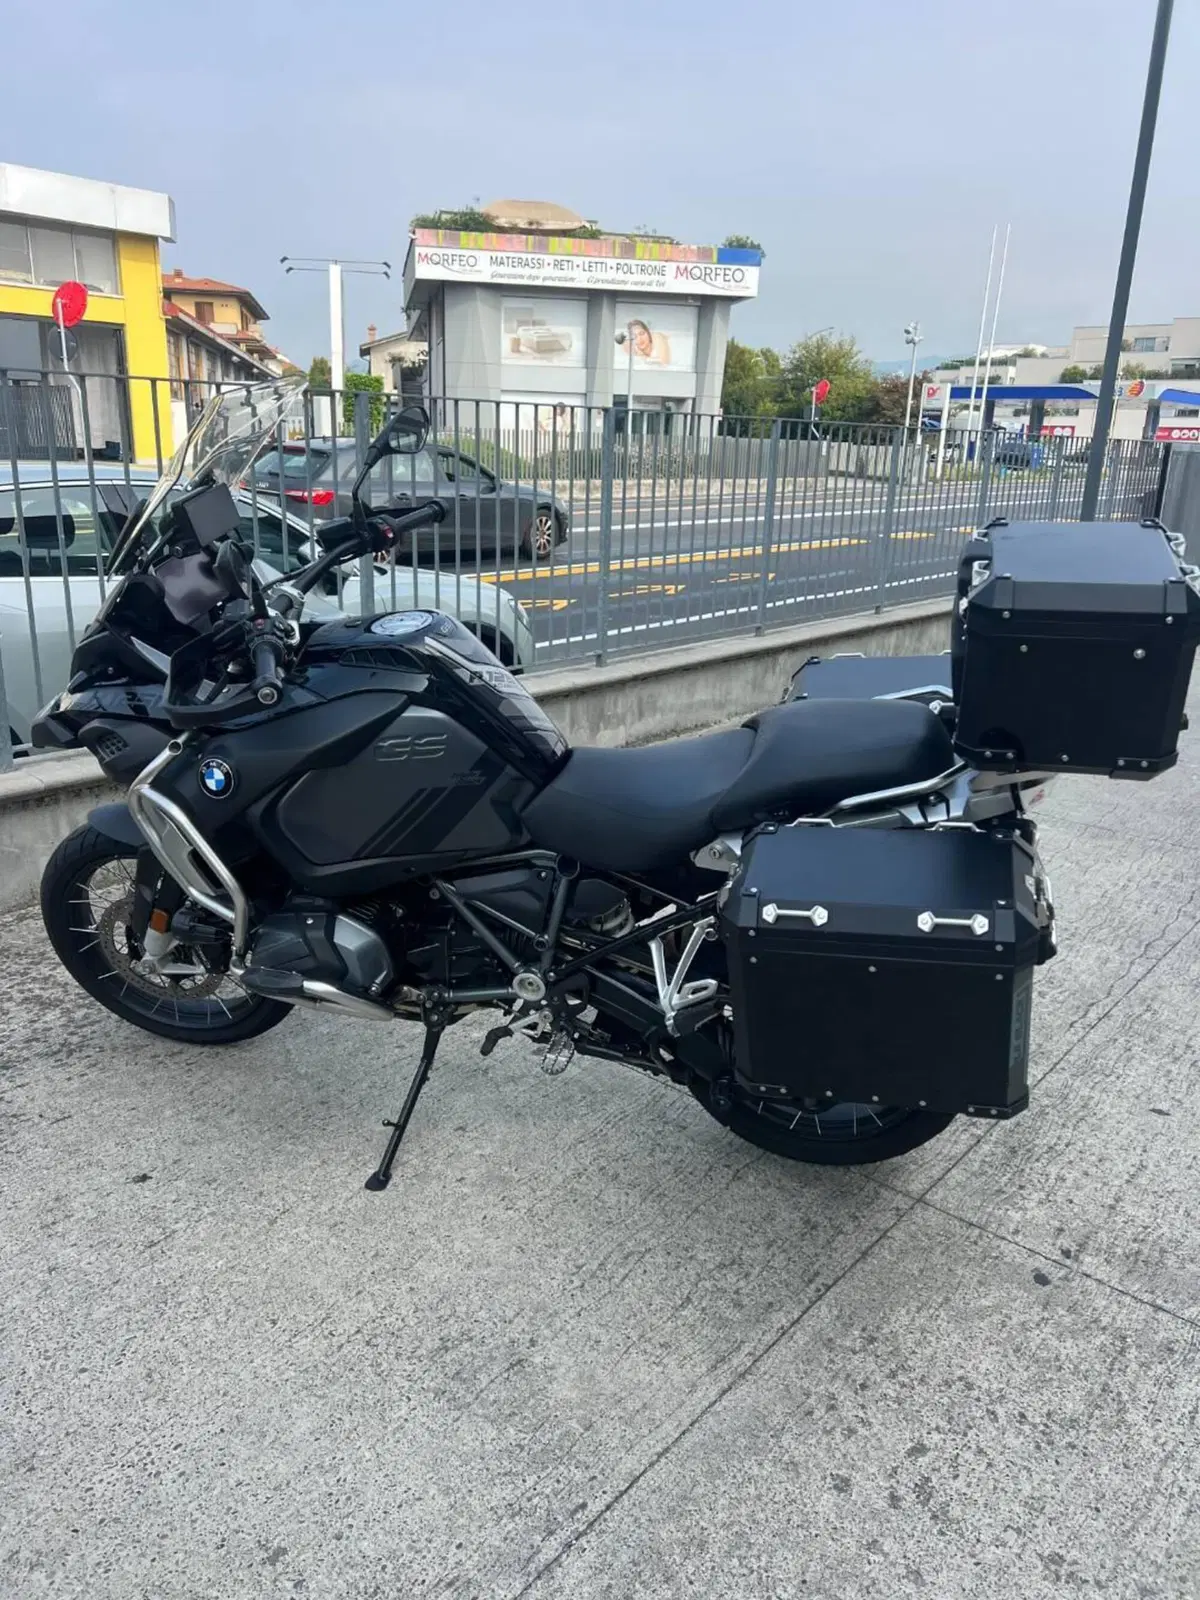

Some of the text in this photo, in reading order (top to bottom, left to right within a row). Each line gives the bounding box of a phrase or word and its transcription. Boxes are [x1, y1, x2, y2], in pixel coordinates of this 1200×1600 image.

[418, 252, 478, 268] MORFEO
[489, 255, 666, 277] MATERASSI RETI LETTI POLTRONE
[674, 265, 745, 283] MORFEO
[374, 733, 448, 762] GS
